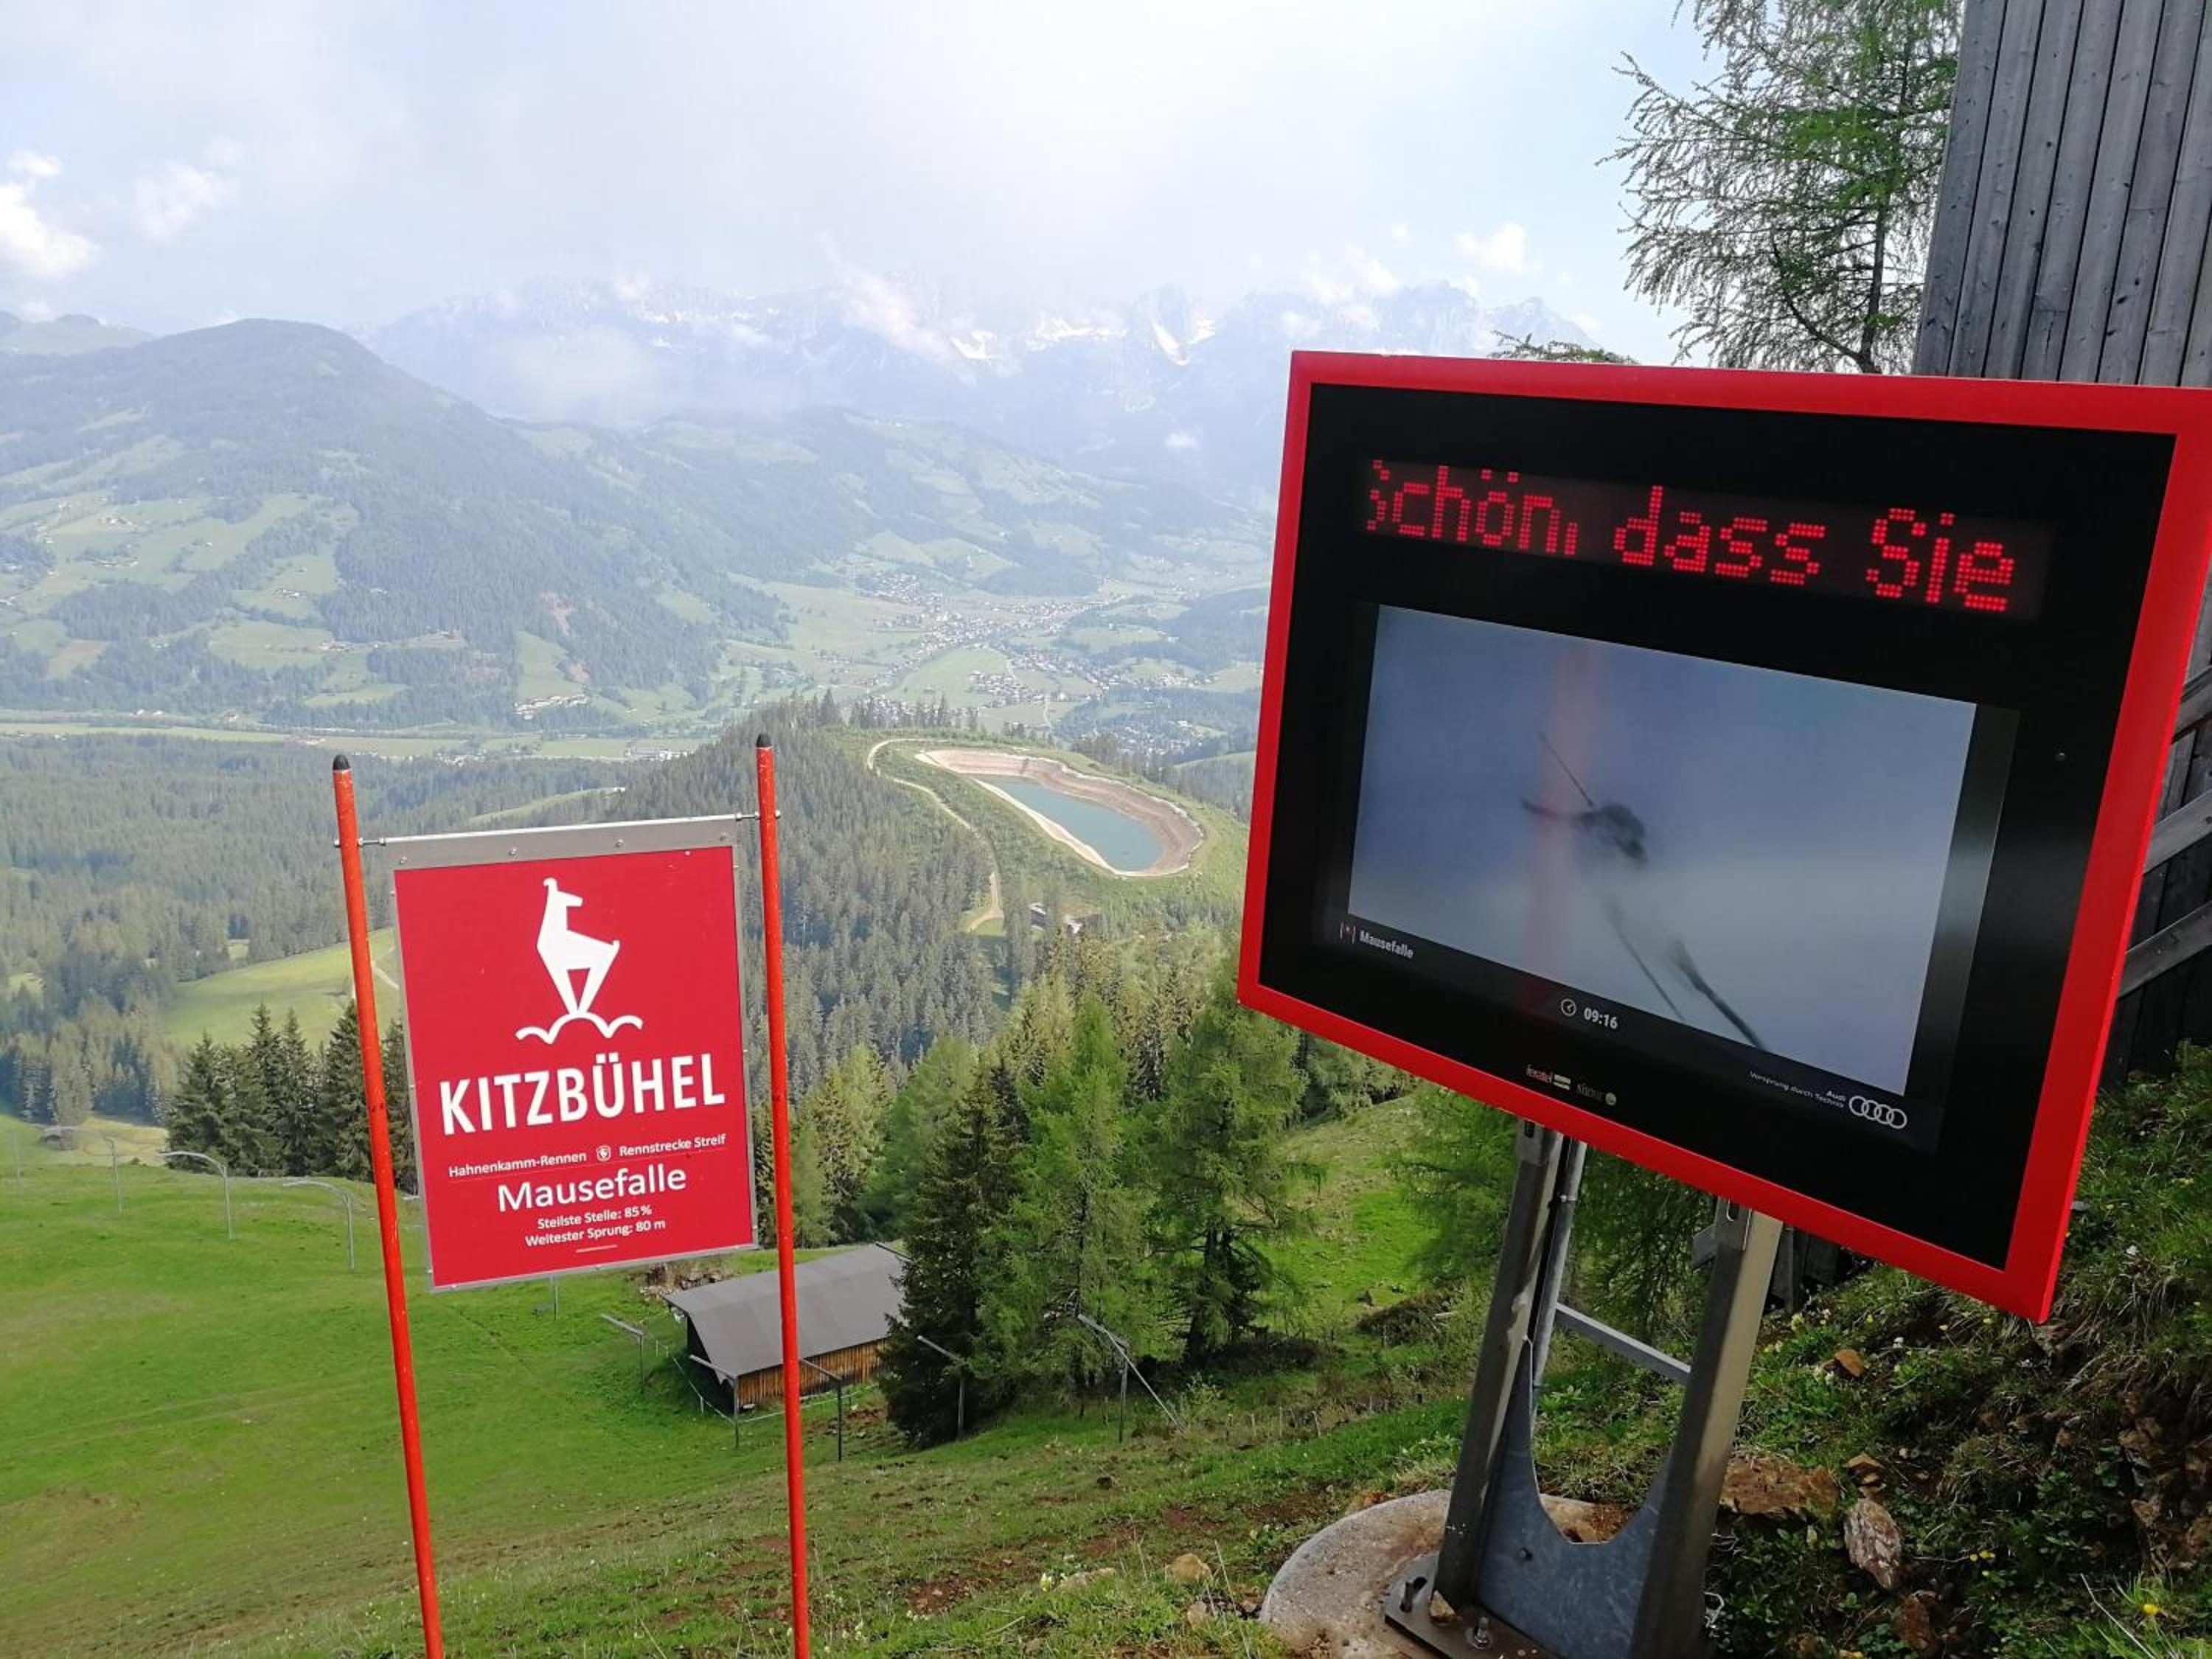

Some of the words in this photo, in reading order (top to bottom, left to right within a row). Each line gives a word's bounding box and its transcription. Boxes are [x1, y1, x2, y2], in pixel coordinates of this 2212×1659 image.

[1614, 484, 1826, 585] dass
[1865, 507, 2014, 612] Sie
[1360, 930, 1413, 959] Mausefalle
[1583, 1006, 1618, 1030] 09:16
[440, 1052, 726, 1135] KITZBÜHEL
[448, 1150, 587, 1178] Hahnenkamm-Rennen
[619, 1138, 692, 1157] Rennstrecke
[693, 1133, 727, 1148] Streif
[498, 1163, 686, 1212] Mausefalle
[524, 1230, 584, 1248] Weitester
[586, 1223, 633, 1240] Sprung:
[635, 1220, 651, 1233] 80
[653, 1219, 666, 1230] m
[537, 1217, 582, 1230] Steilste
[584, 1208, 622, 1224] Stelle:
